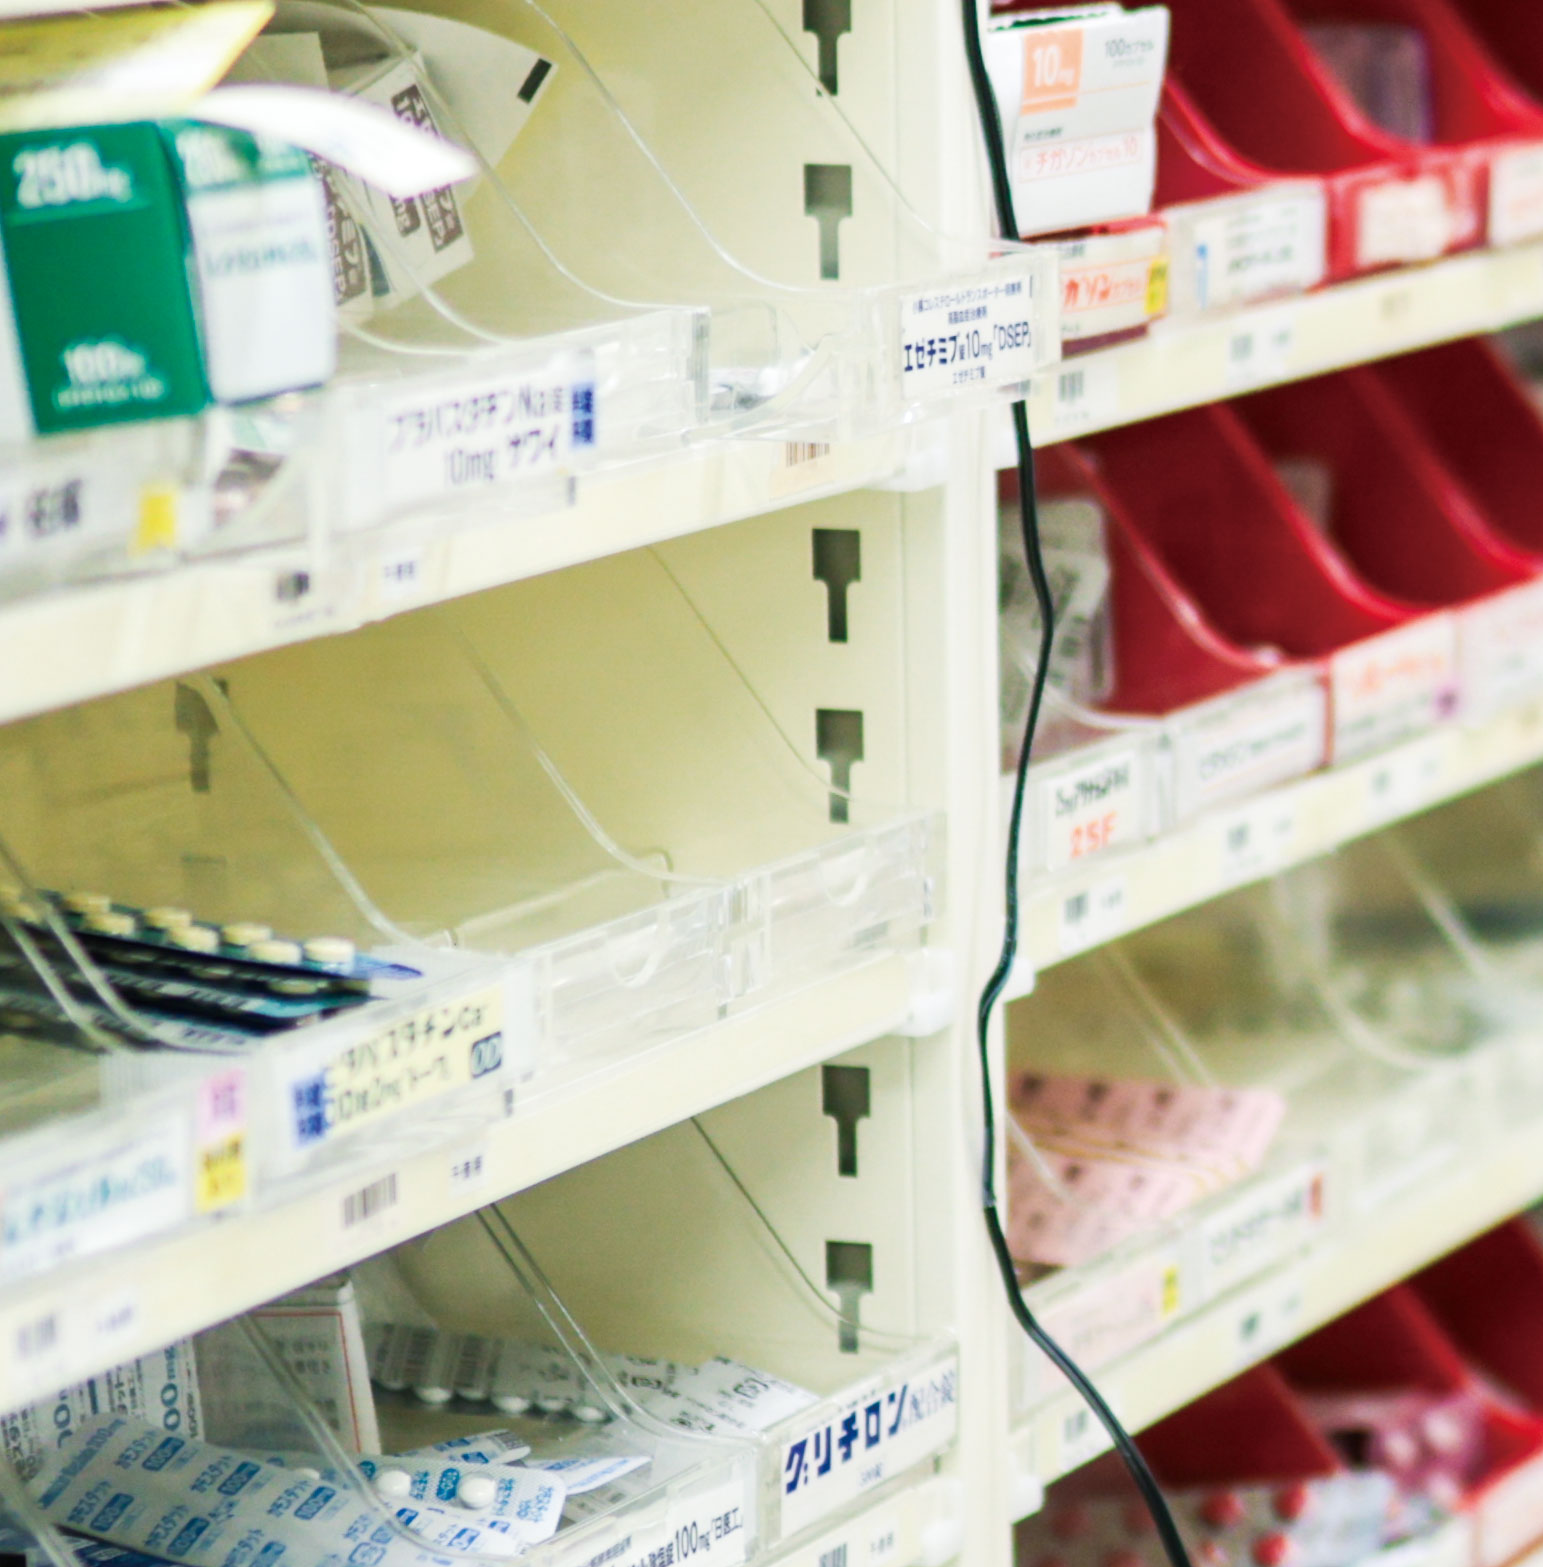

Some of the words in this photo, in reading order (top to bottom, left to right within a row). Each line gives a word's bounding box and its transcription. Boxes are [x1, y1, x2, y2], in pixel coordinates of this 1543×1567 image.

[904, 321, 1032, 373] エゼチミブ錠10mg「DSEP」
